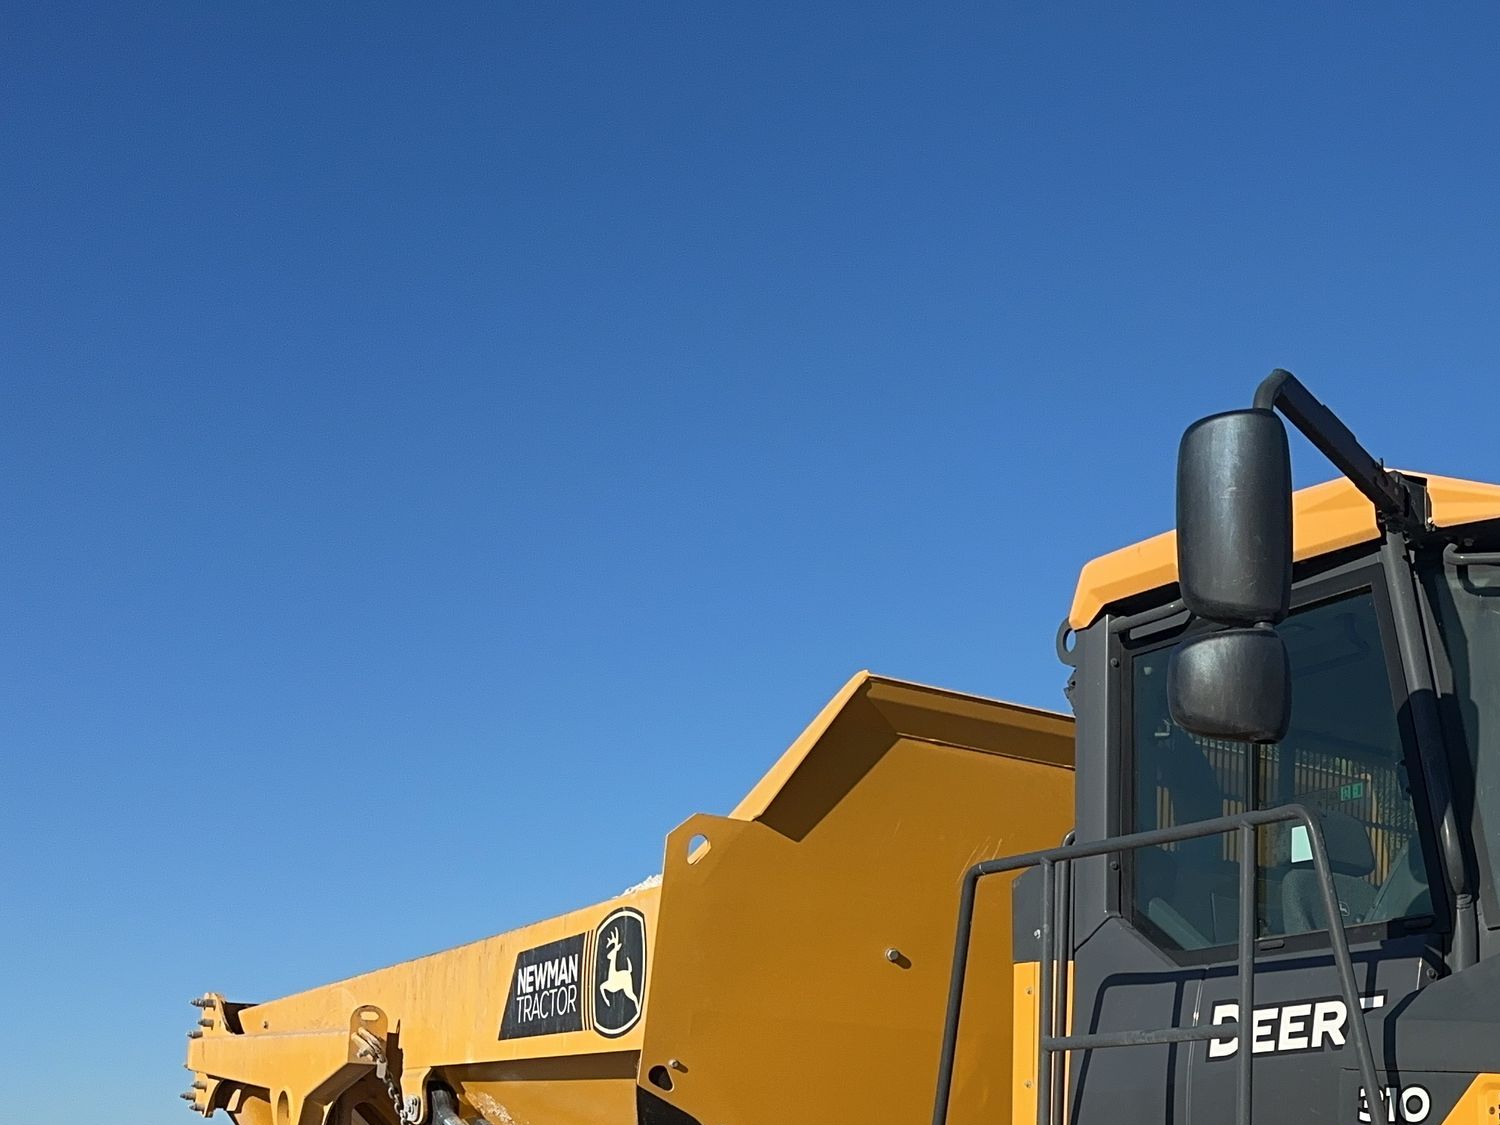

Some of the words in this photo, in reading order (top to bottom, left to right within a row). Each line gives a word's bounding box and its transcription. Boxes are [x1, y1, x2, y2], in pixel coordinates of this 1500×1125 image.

[517, 953, 579, 996] NEWMAN
[516, 984, 578, 1024] TRACTOR
[1208, 995, 1385, 1058] DEER
